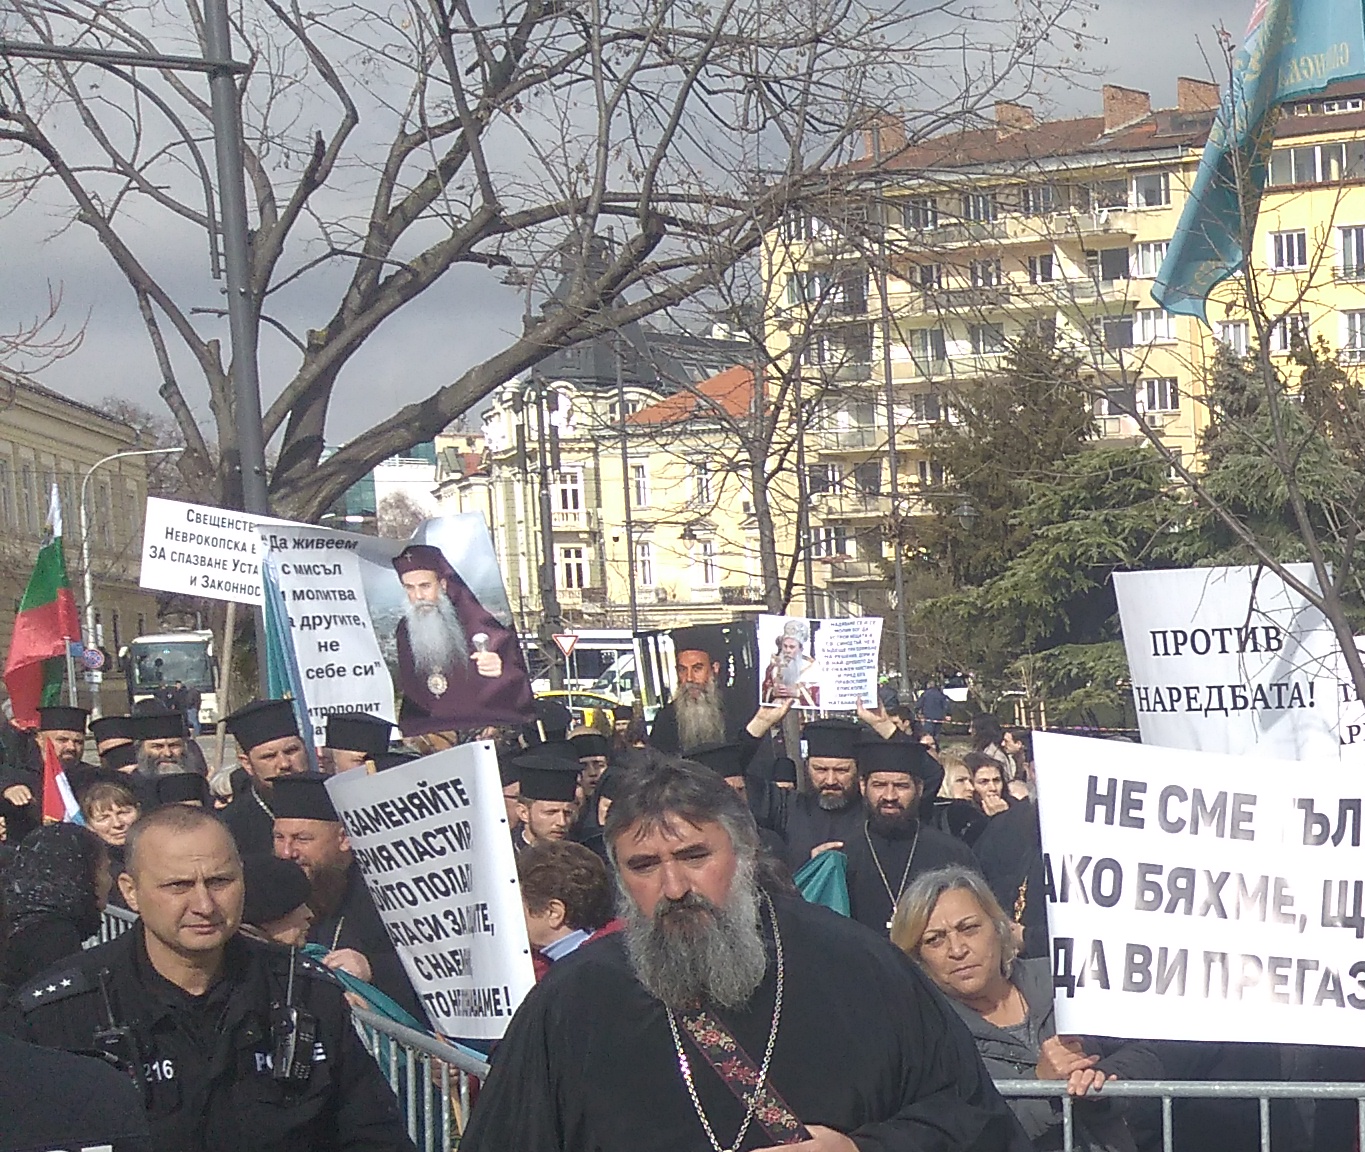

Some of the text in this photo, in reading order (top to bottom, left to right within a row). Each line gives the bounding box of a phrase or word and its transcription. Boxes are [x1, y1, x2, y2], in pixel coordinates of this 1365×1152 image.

[292, 535, 359, 550] живеем
[149, 545, 166, 562] ЗА
[294, 562, 342, 576] мисъл
[292, 589, 357, 601] молитва
[299, 614, 366, 631] другите,
[317, 640, 340, 652] не
[1150, 626, 1283, 656] ПРОТИВ
[305, 663, 347, 680] себе
[1135, 681, 1316, 717] НАРЕДБАТА!
[345, 778, 470, 837] ЗАМЕНЯЙТЕ
[1085, 775, 1148, 830] НЕ
[1157, 784, 1258, 842] СМЕ
[1134, 862, 1308, 933] БЯХМЕ,
[1053, 937, 1110, 999] ДА
[1122, 943, 1189, 996] ВИ
